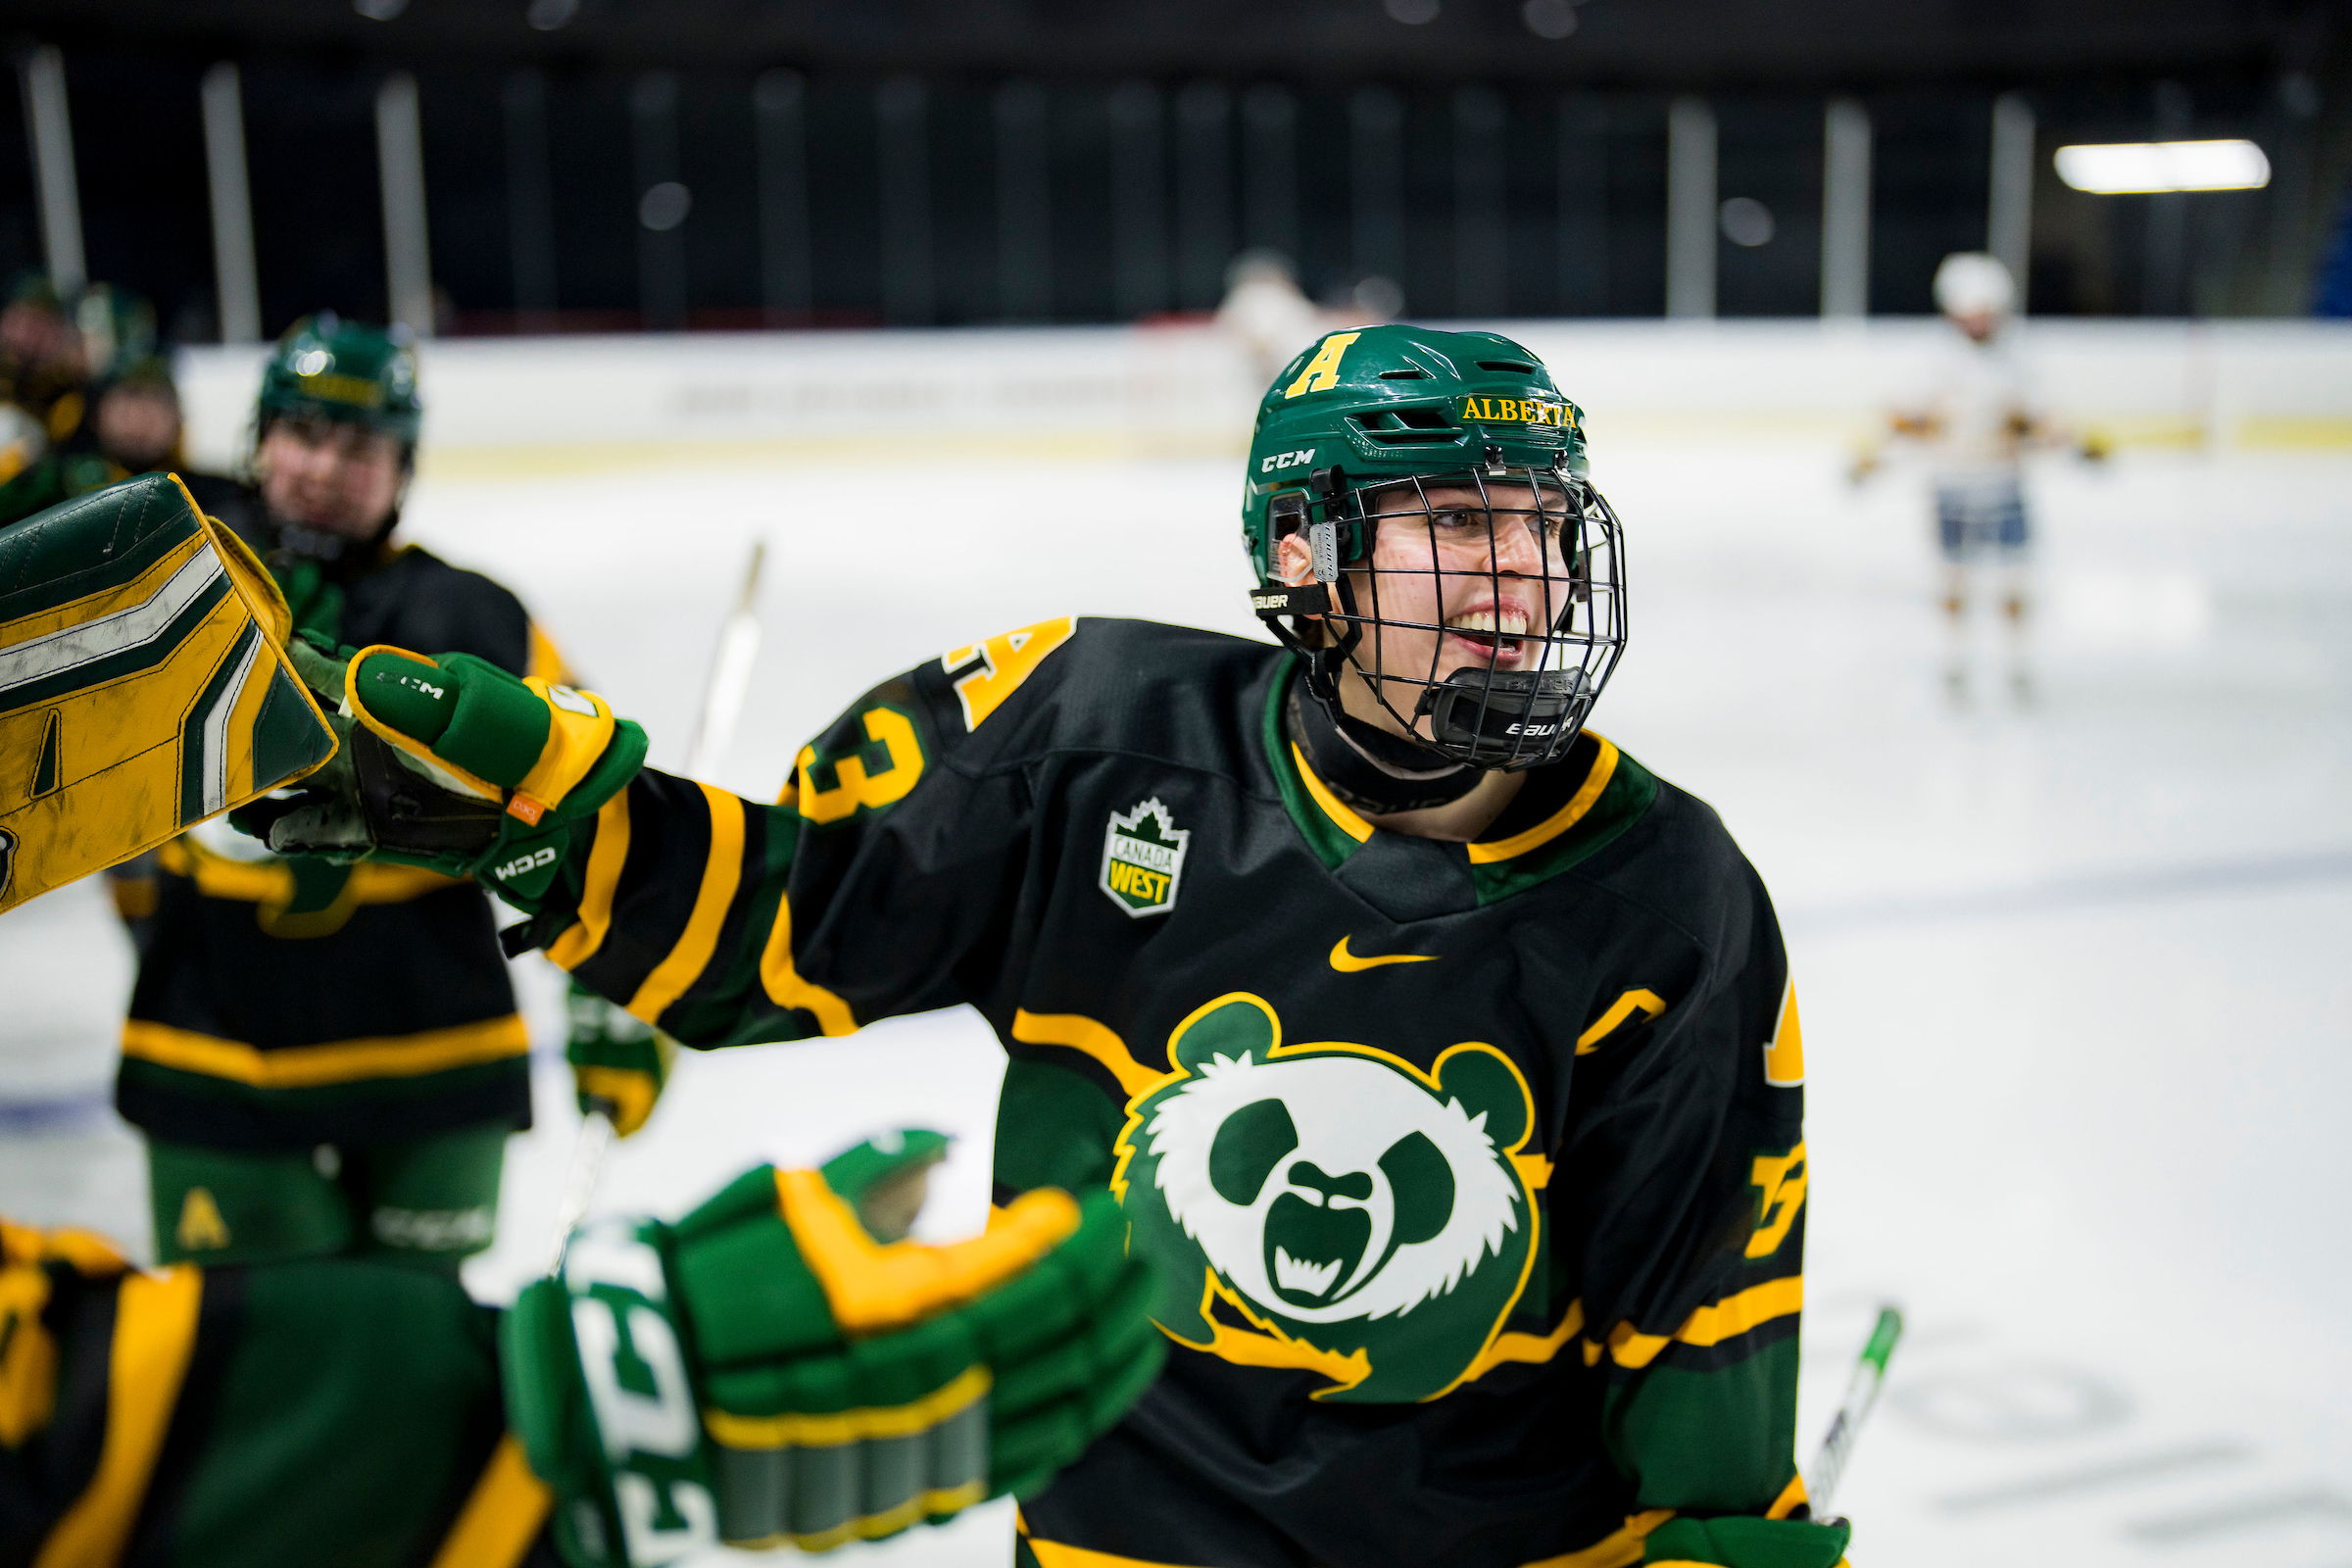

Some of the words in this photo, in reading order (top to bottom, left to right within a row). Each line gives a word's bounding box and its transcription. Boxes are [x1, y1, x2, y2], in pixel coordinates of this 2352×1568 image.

[1285, 332, 1361, 399] A
[1462, 397, 1577, 428] ALBERTA
[1261, 449, 1315, 472] CCM
[1252, 594, 1289, 610] AUER
[1505, 716, 1574, 737] BAUR
[798, 707, 925, 825] 3
[494, 847, 556, 881] CCM
[1113, 838, 1173, 868] CANADA
[1109, 859, 1172, 904] WEST
[176, 1186, 232, 1252] A
